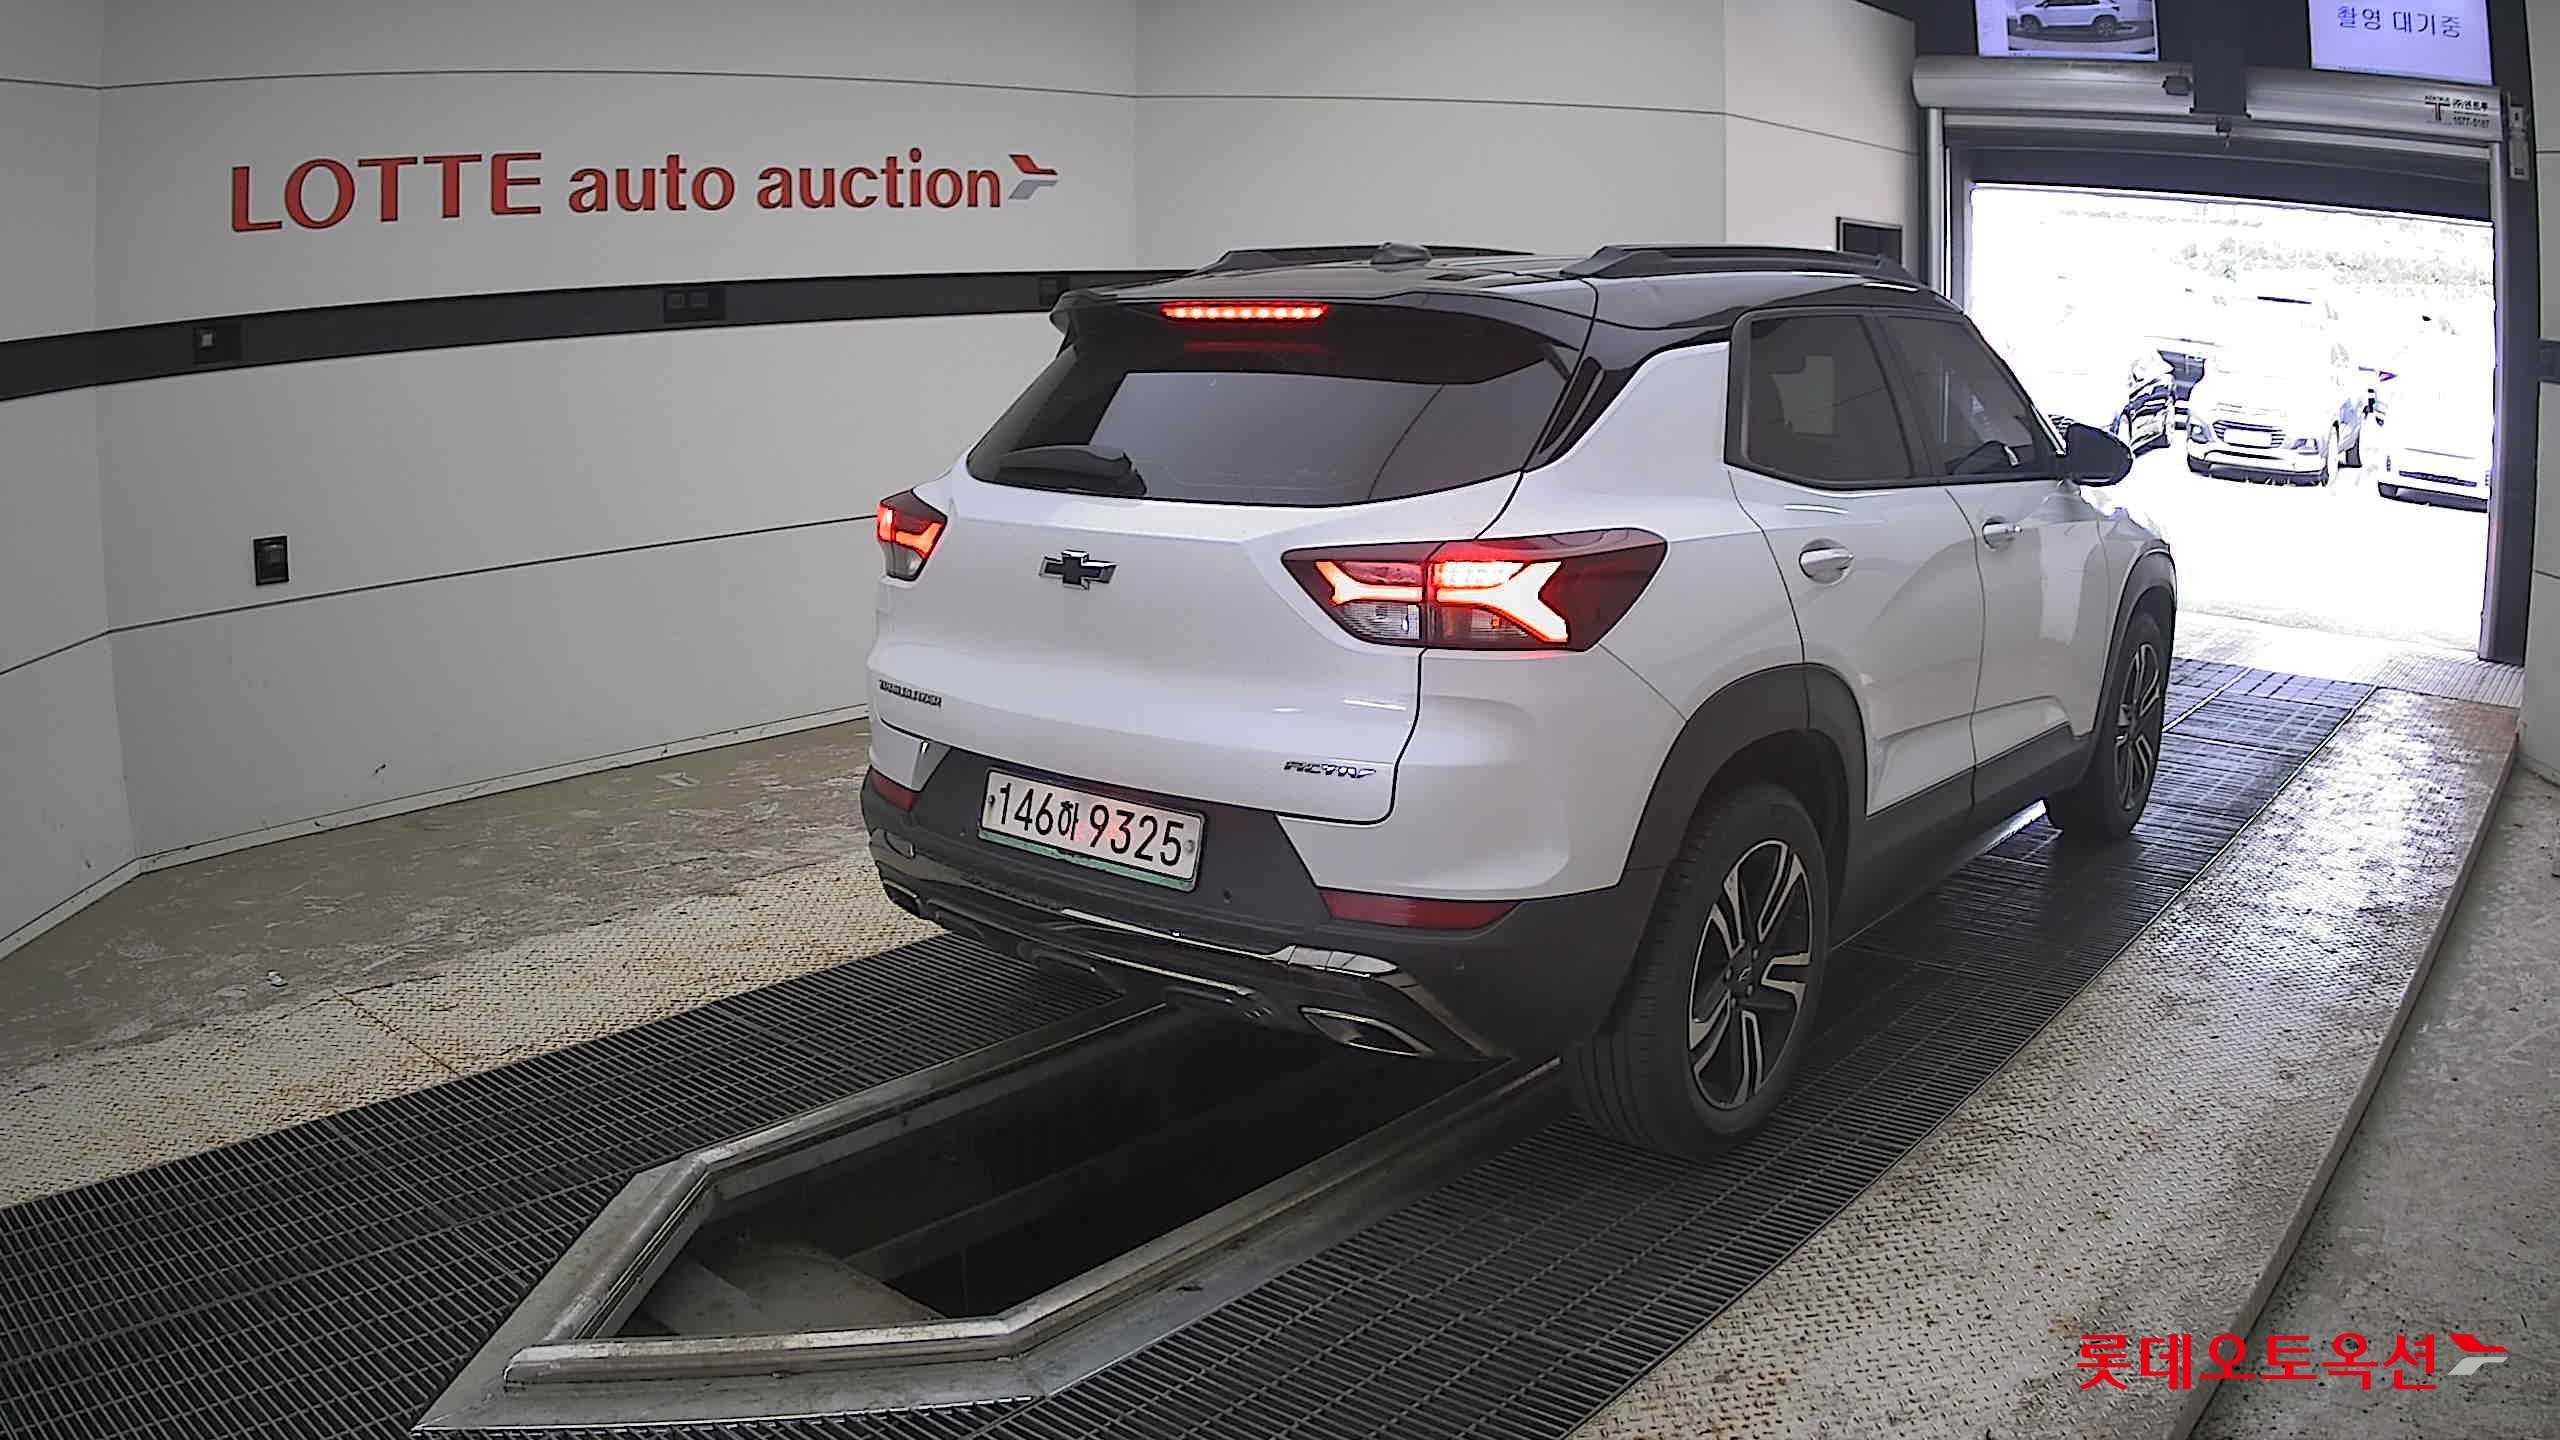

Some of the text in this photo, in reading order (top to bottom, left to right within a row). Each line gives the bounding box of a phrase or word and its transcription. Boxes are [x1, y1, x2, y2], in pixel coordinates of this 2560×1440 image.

[2392, 11, 2463, 38] 대기중
[231, 147, 1001, 232] LOTTE auto auction
[1089, 804, 1184, 866] 9325
